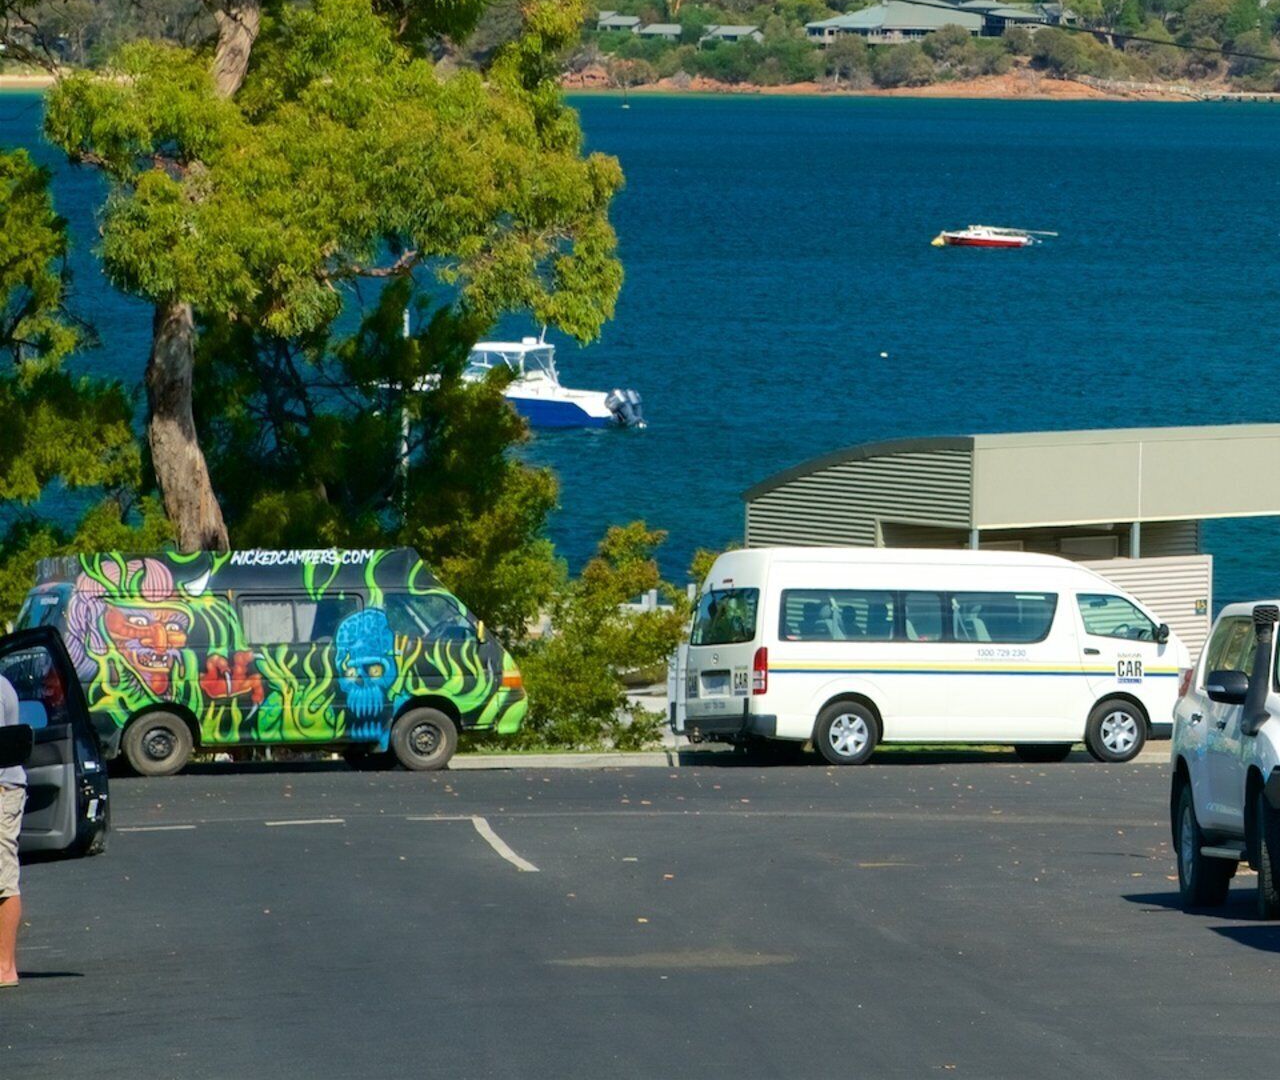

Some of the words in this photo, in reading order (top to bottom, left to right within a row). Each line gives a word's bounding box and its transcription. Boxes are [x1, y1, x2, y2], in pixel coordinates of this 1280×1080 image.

[230, 549, 375, 566] WICKEDCAMPERS.COM
[1117, 660, 1142, 677] CAR
[734, 672, 748, 690] CAR
